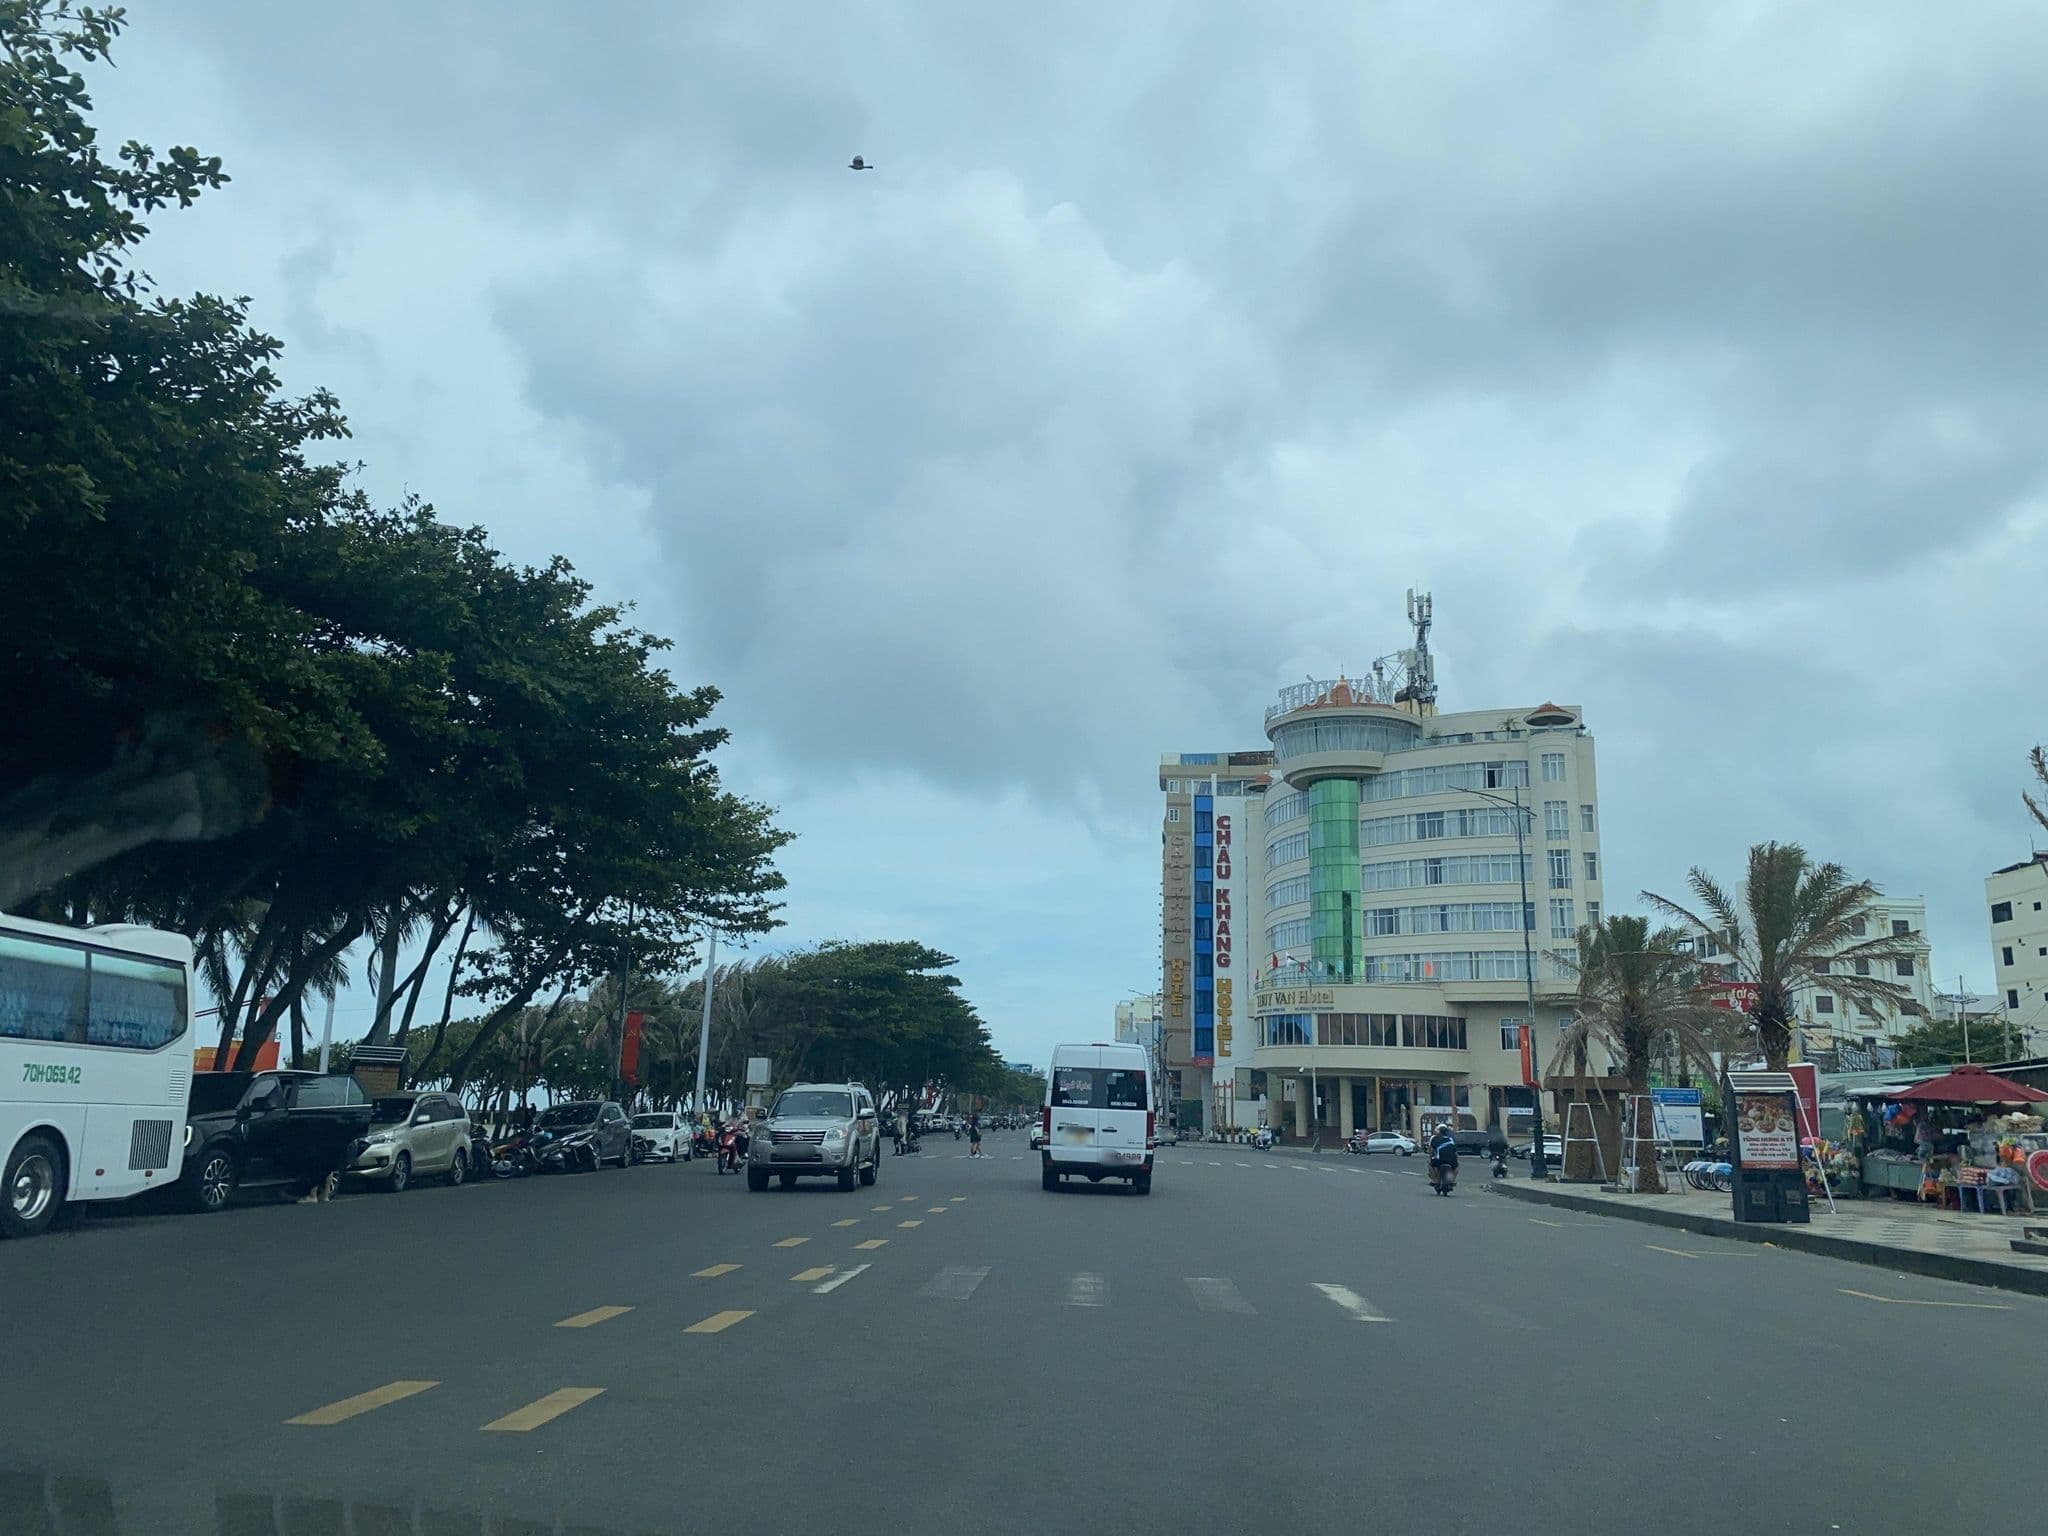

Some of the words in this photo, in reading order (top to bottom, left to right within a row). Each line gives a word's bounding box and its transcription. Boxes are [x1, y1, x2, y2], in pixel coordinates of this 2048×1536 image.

[1216, 815, 1231, 880] CHÂU
[1216, 888, 1231, 968] KHANG
[1171, 959, 1184, 1018] HOTEL
[1217, 978, 1232, 1057] HOTEL
